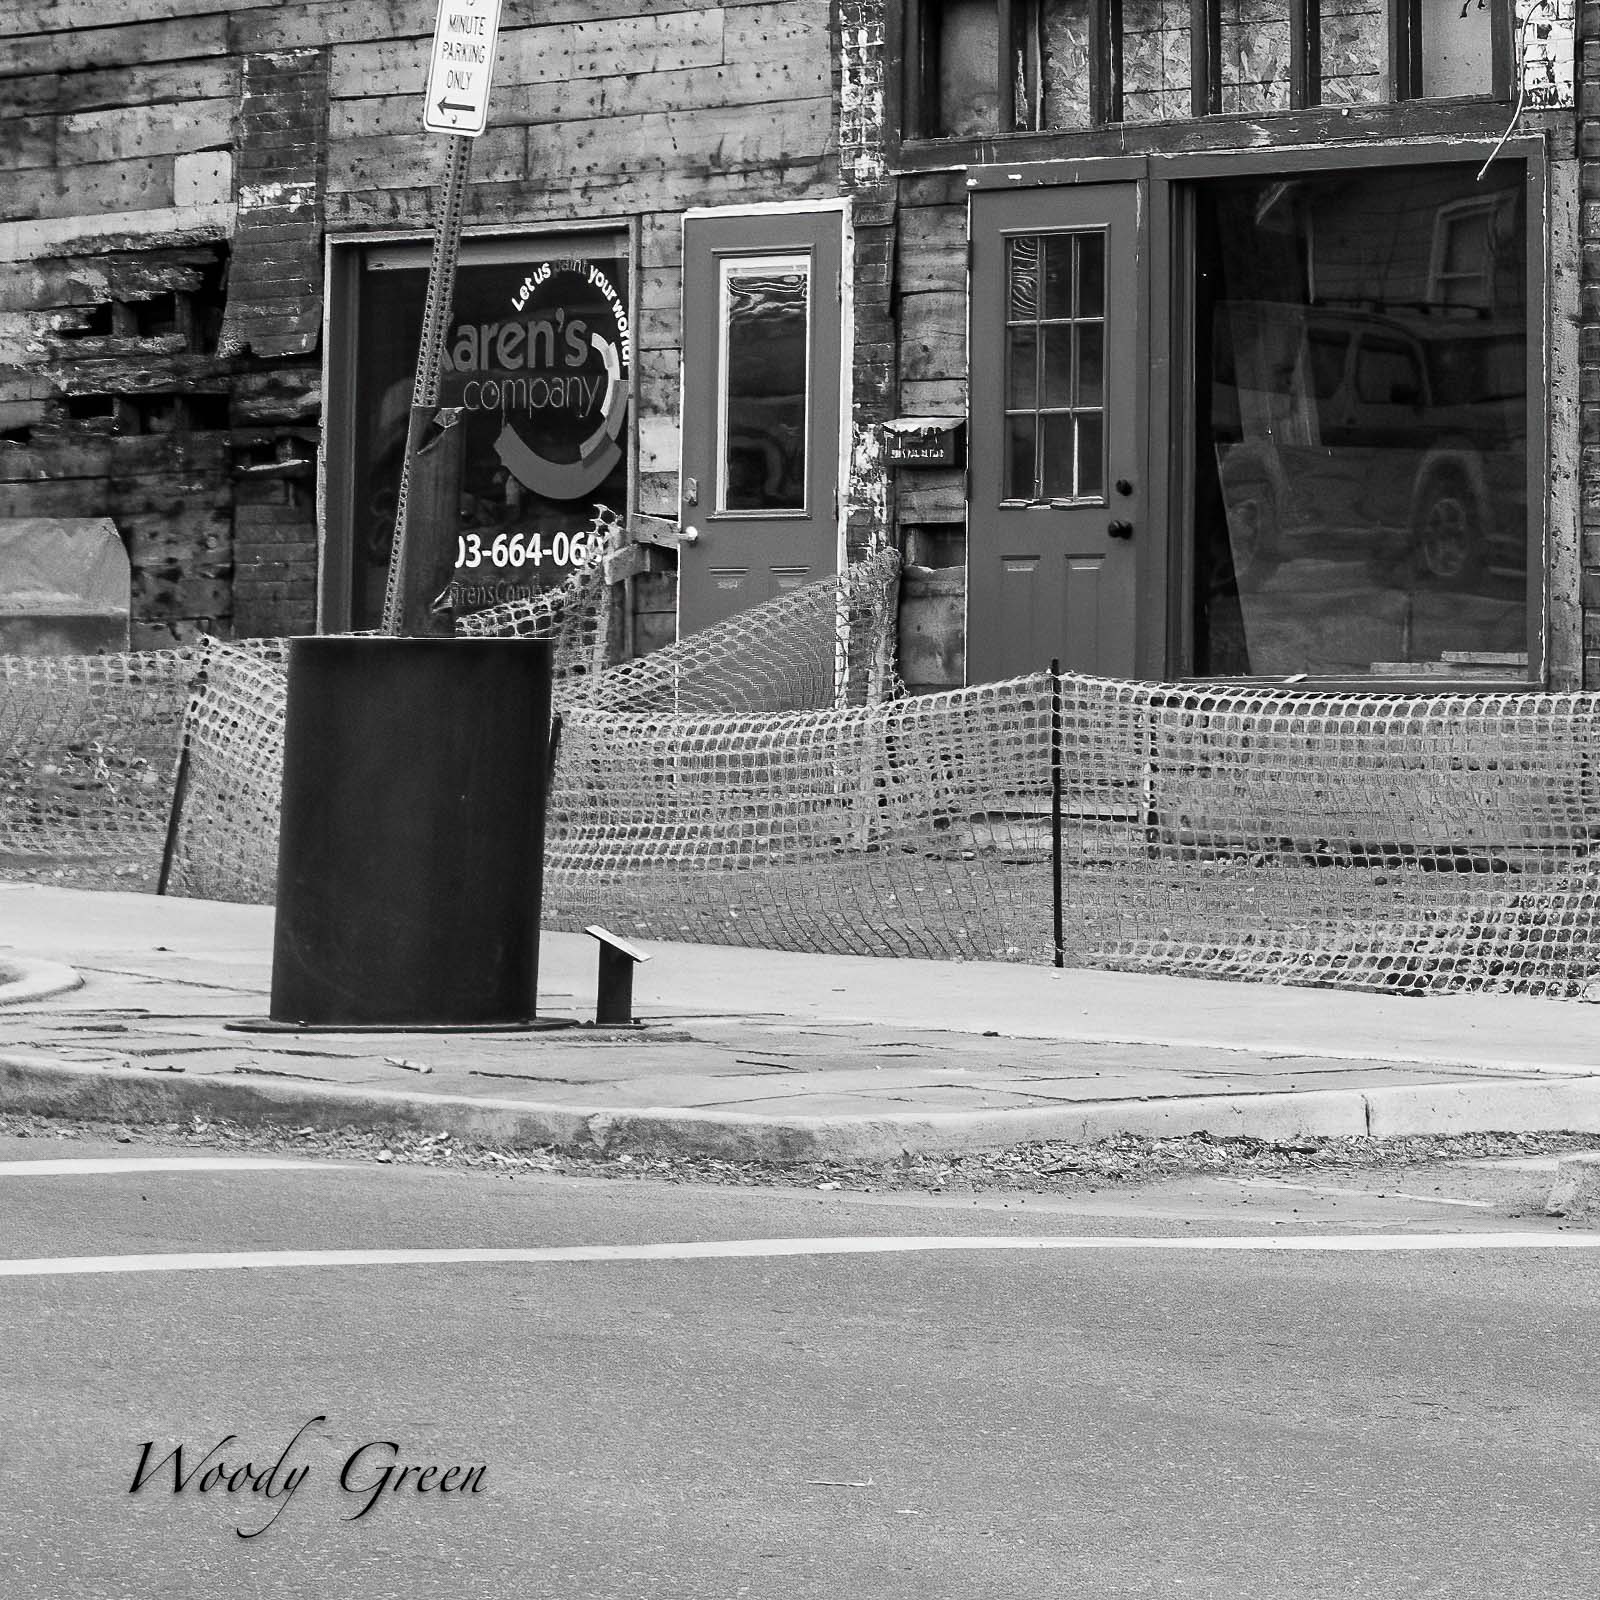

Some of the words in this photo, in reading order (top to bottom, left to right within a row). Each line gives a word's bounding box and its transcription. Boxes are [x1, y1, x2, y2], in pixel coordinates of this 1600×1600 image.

[448, 14, 486, 36] MINUTE
[442, 41, 486, 64] PARKING
[447, 70, 472, 90] ONLY
[512, 277, 535, 311] Let
[533, 262, 551, 284] us
[587, 265, 617, 301] your
[440, 307, 588, 373] aren's
[464, 376, 600, 419] company
